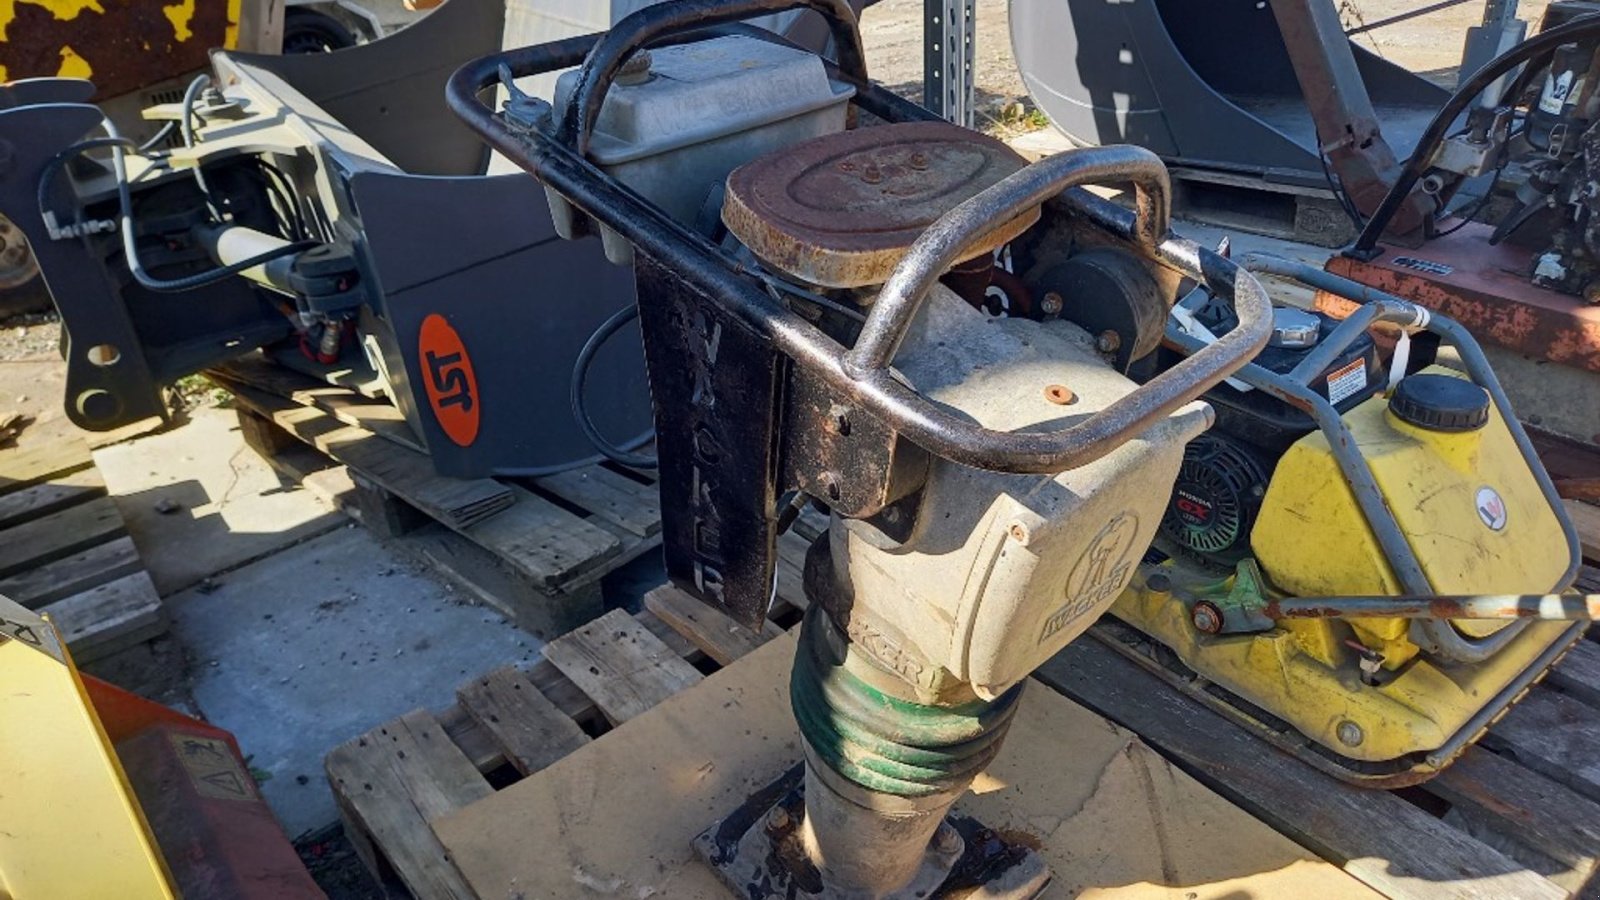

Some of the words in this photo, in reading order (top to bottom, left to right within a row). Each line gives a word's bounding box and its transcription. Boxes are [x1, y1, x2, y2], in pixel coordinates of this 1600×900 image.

[425, 350, 473, 412] JST
[1177, 498, 1210, 521] GX
[1178, 489, 1213, 510] HONDA
[1039, 563, 1128, 643] WACKER
